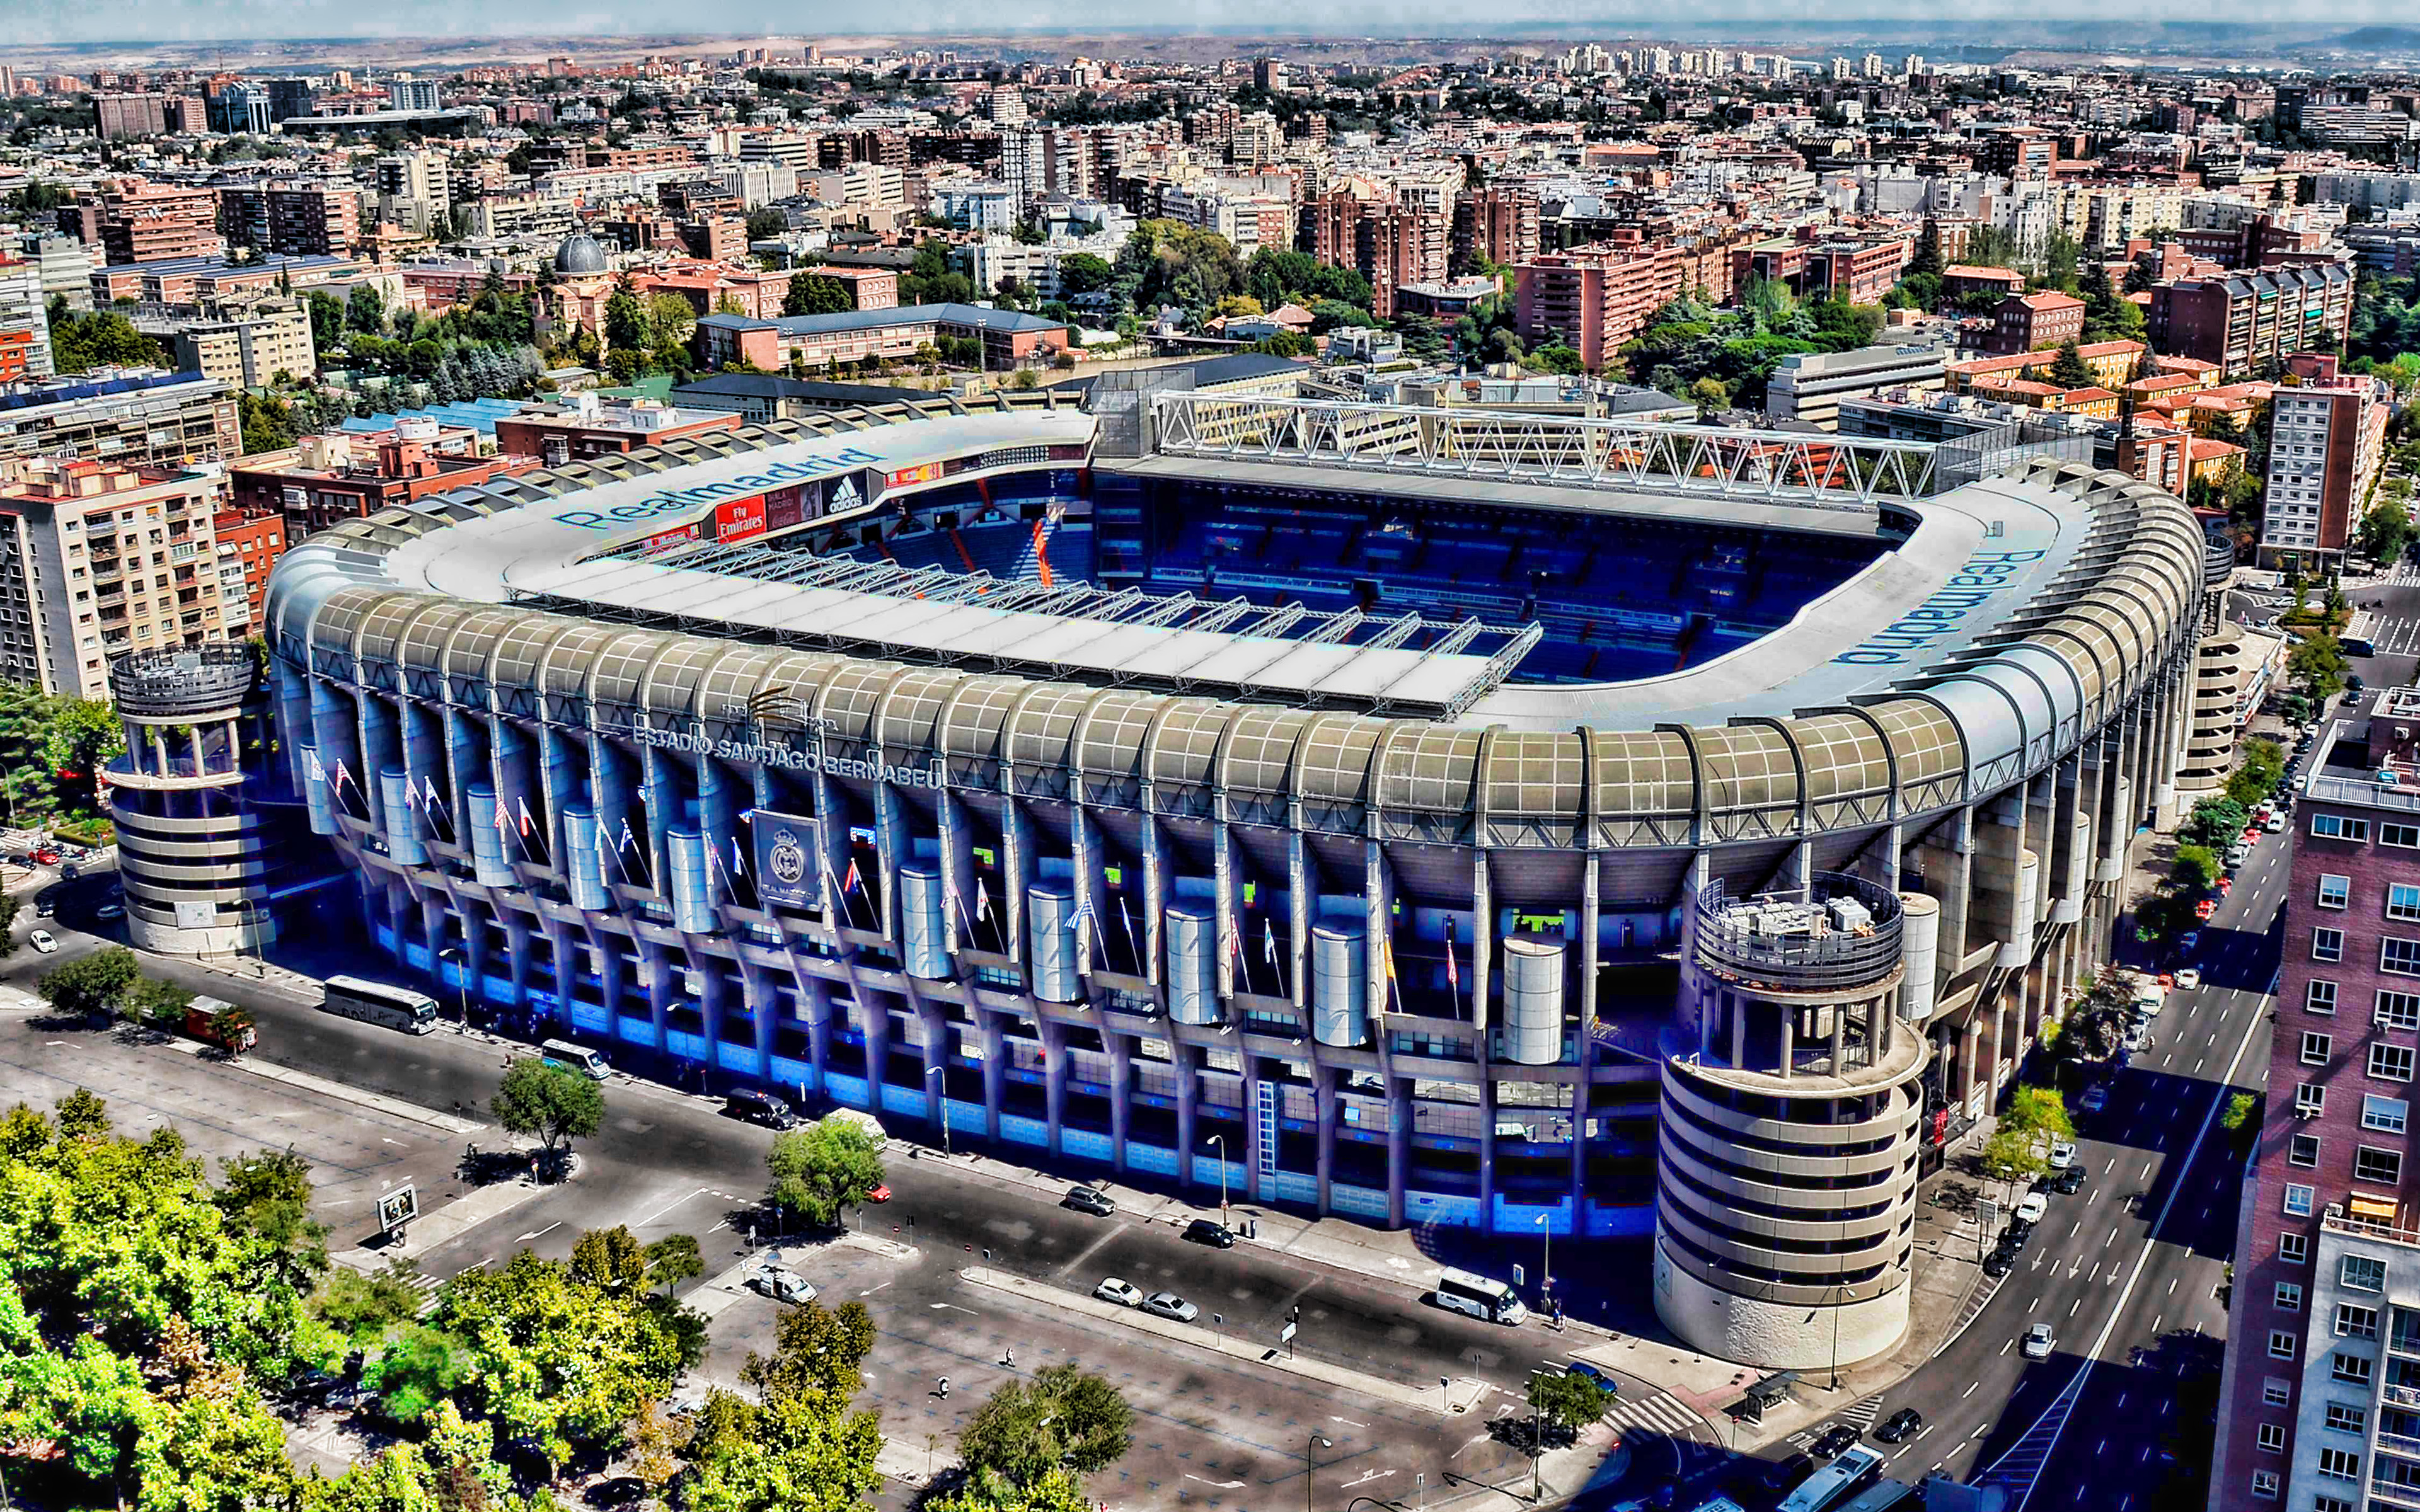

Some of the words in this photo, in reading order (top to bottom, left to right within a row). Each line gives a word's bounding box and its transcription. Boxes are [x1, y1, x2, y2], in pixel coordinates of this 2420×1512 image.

[733, 507, 747, 518] Fly
[829, 496, 863, 513] adidas
[719, 515, 763, 537] Emirates
[632, 725, 713, 755] ESTADIO
[715, 739, 819, 772] SANTIAGO
